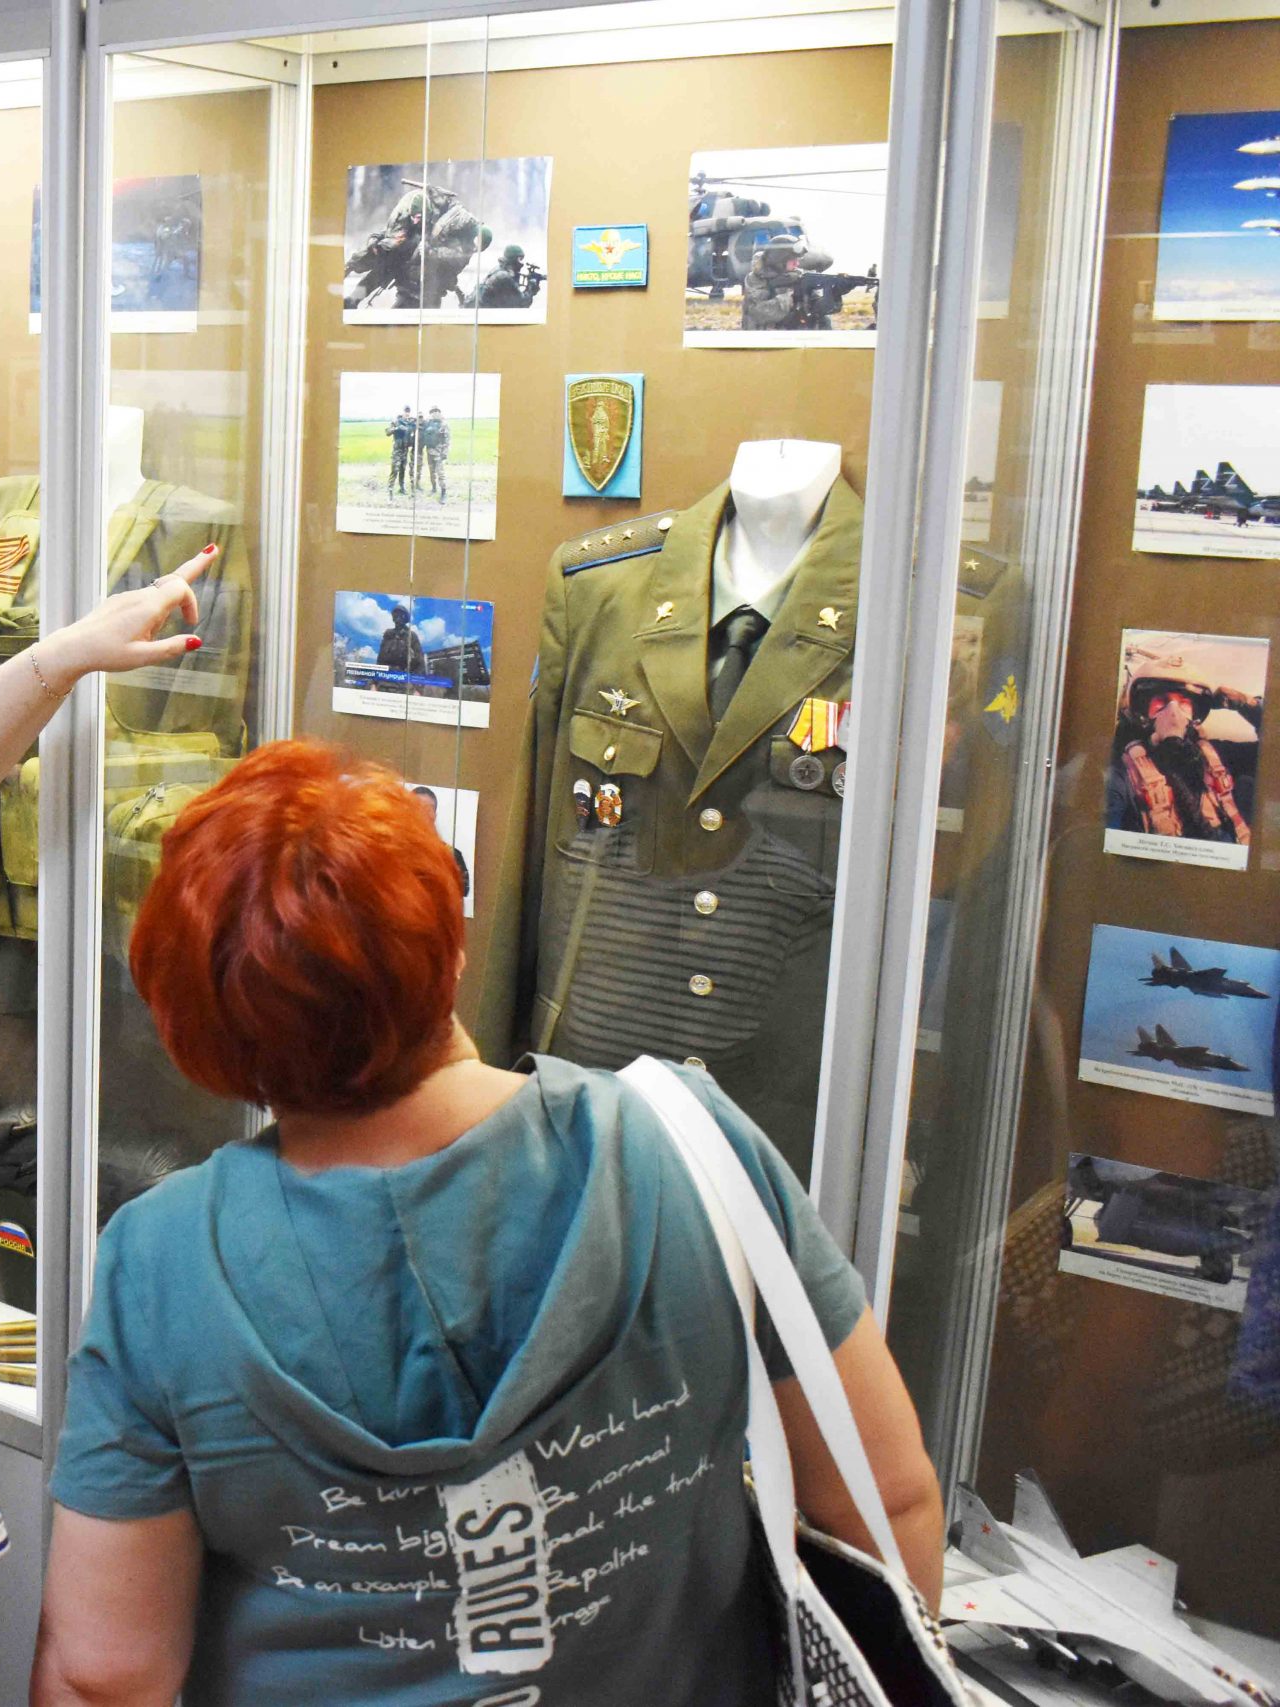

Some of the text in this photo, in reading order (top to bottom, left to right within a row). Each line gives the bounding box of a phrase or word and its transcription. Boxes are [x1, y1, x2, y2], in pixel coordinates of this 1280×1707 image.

[535, 1379, 690, 1460] Work hard
[538, 1435, 671, 1516] Be normal
[320, 1486, 367, 1513] Be
[613, 1490, 657, 1518] the
[279, 1523, 448, 1557] Dream big
[454, 1502, 545, 1654] RULES
[546, 1539, 650, 1595] Be polite
[313, 1580, 343, 1593] an
[350, 1569, 452, 1603] example
[359, 1625, 436, 1650] Listen
